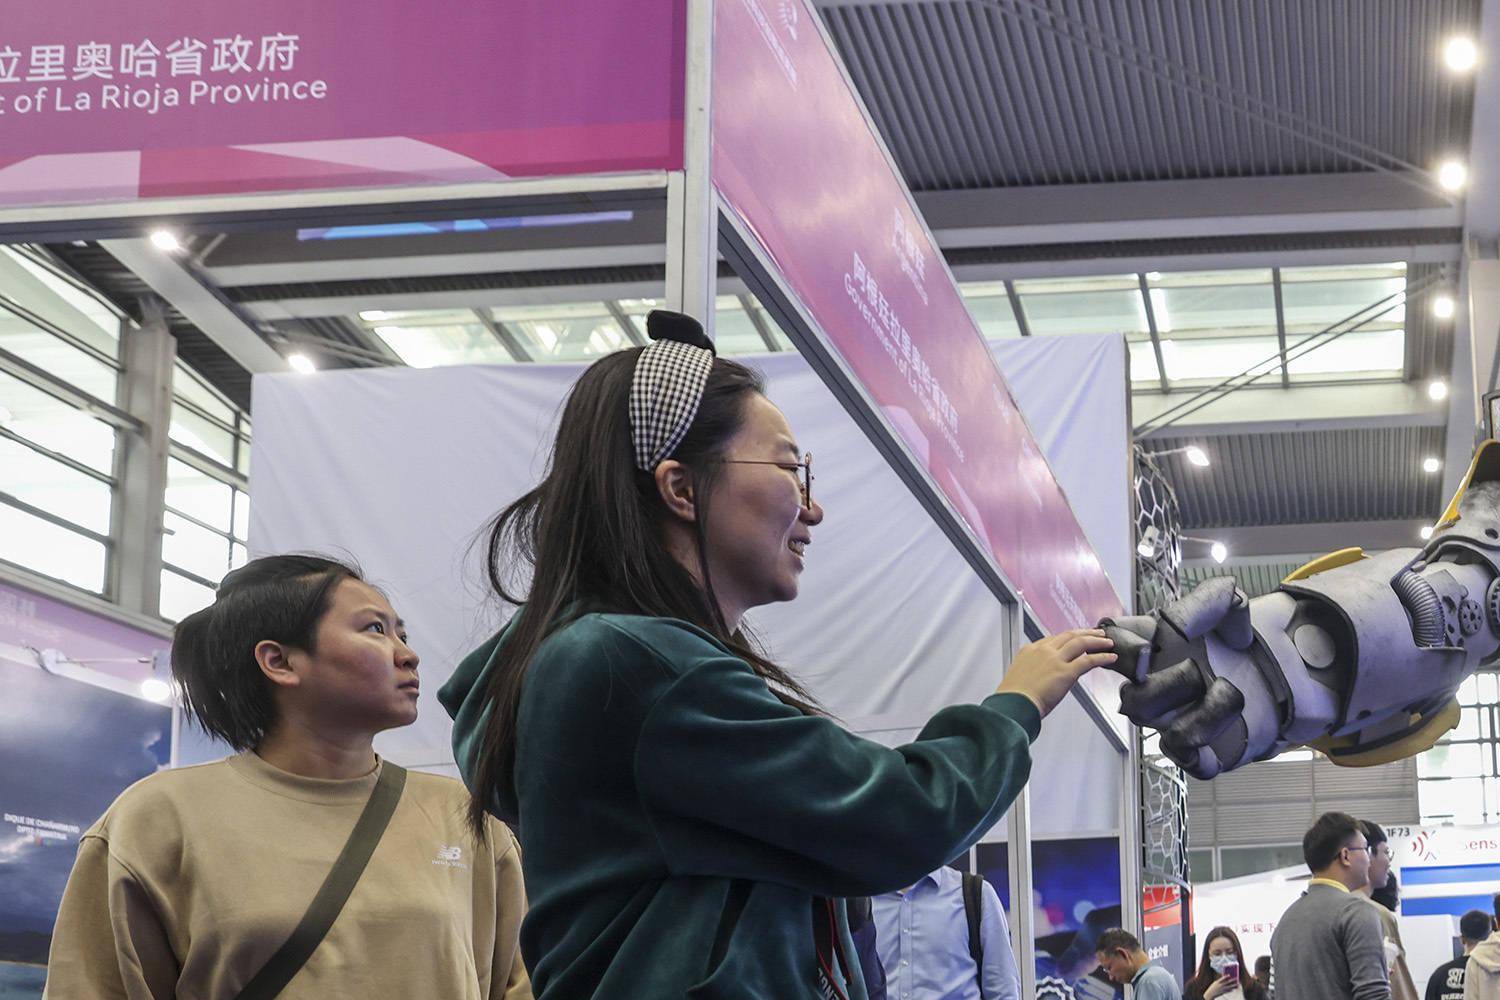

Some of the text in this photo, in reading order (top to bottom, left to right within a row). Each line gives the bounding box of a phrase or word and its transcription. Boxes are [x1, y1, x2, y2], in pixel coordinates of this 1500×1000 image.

[13, 86, 48, 114] of
[55, 86, 92, 112] La
[101, 83, 180, 114] Rioja
[189, 77, 328, 106] Province
[1386, 827, 1410, 838] 1F73
